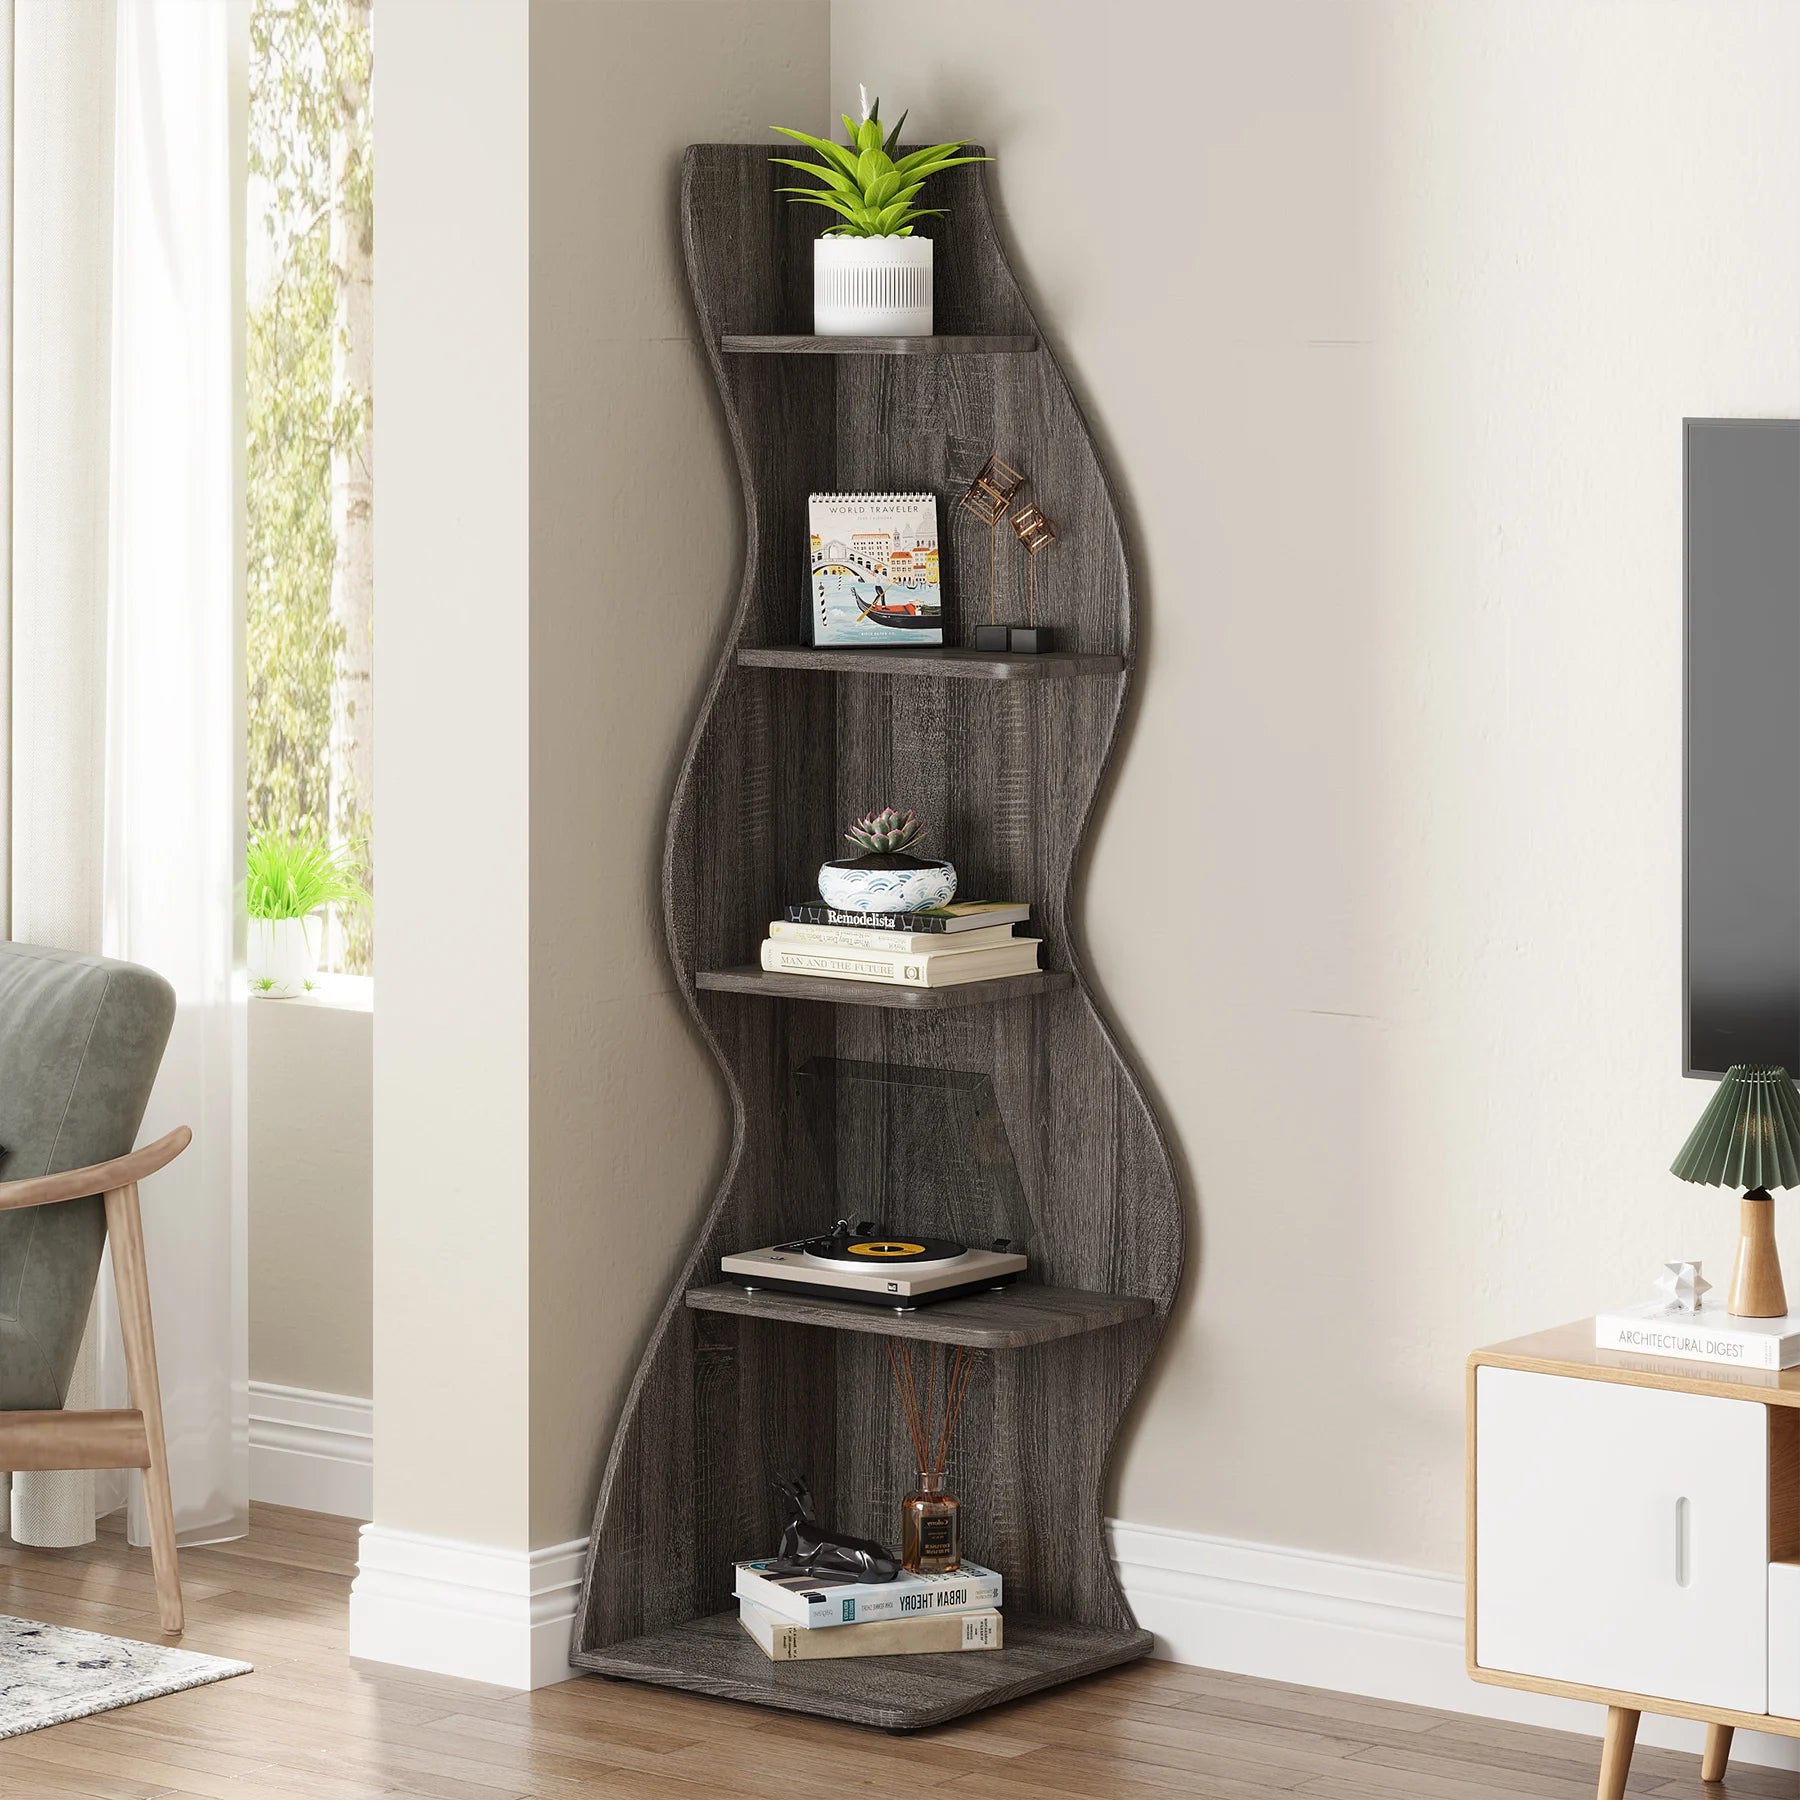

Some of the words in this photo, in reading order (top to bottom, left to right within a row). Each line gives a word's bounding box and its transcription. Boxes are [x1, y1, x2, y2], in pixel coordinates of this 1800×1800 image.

[828, 506, 865, 514] WORLD
[870, 505, 919, 513] TRAVELER
[827, 910, 896, 928] Remodelista
[781, 955, 802, 967] MAN
[805, 957, 828, 969] AND
[829, 961, 852, 971] THE
[853, 963, 894, 976] FUTURE
[1619, 1330, 1704, 1354] ARCHITECTURAL
[1706, 1341, 1745, 1359] DIGEST
